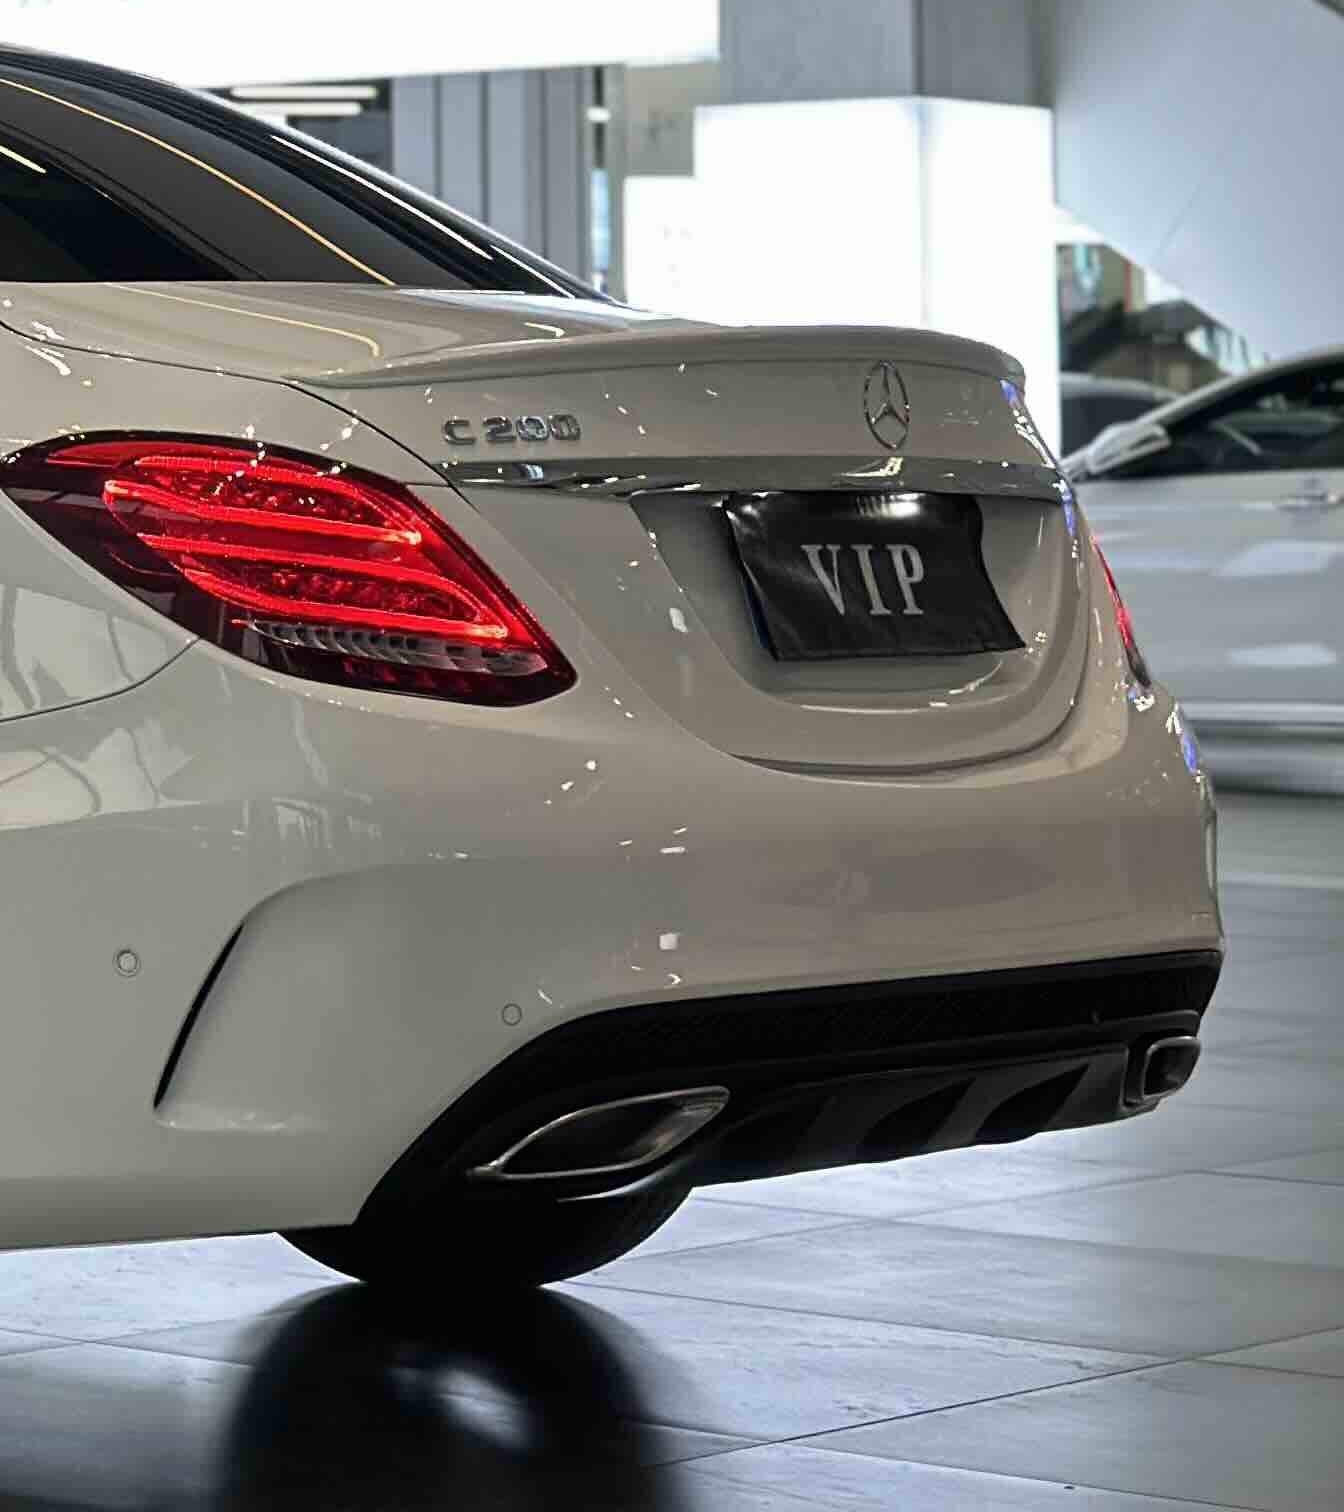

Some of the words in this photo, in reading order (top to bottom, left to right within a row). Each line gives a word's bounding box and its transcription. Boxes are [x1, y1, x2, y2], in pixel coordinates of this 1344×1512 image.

[442, 416, 477, 445] C
[483, 413, 582, 443] 200
[801, 543, 925, 616] VIP
